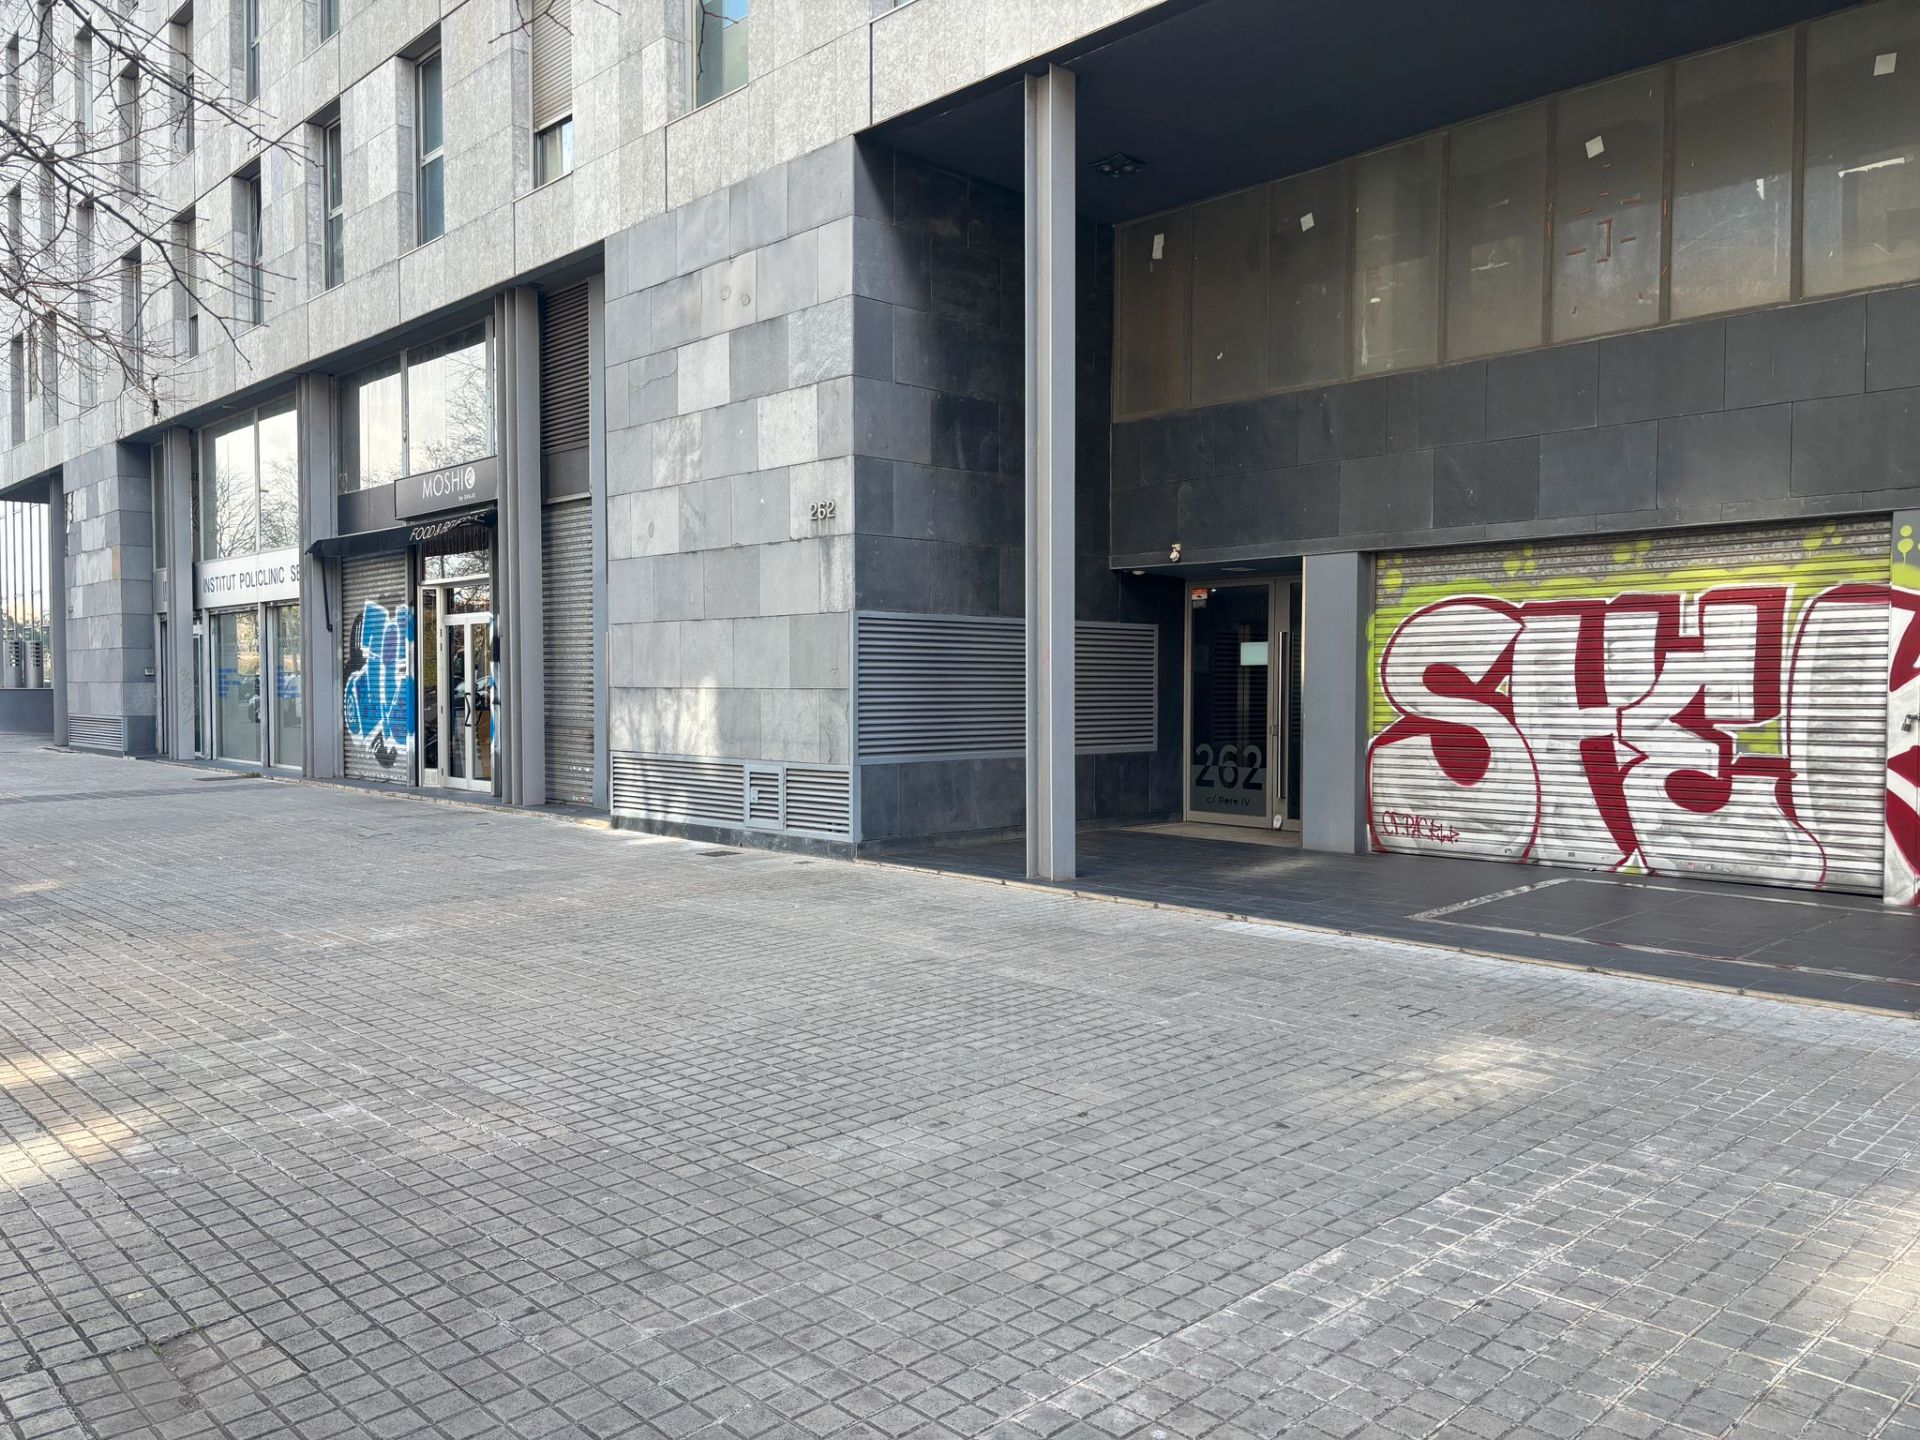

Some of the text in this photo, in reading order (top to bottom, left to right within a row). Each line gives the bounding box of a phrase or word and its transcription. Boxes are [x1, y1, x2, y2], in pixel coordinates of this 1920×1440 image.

[809, 500, 836, 521] 262
[409, 524, 436, 542] FOOD
[203, 574, 236, 594] INSTITUT
[239, 566, 285, 589] POLICLINIC
[1195, 743, 1263, 791] 262
[1218, 796, 1239, 807] Pere
[1241, 798, 1251, 807] IV
